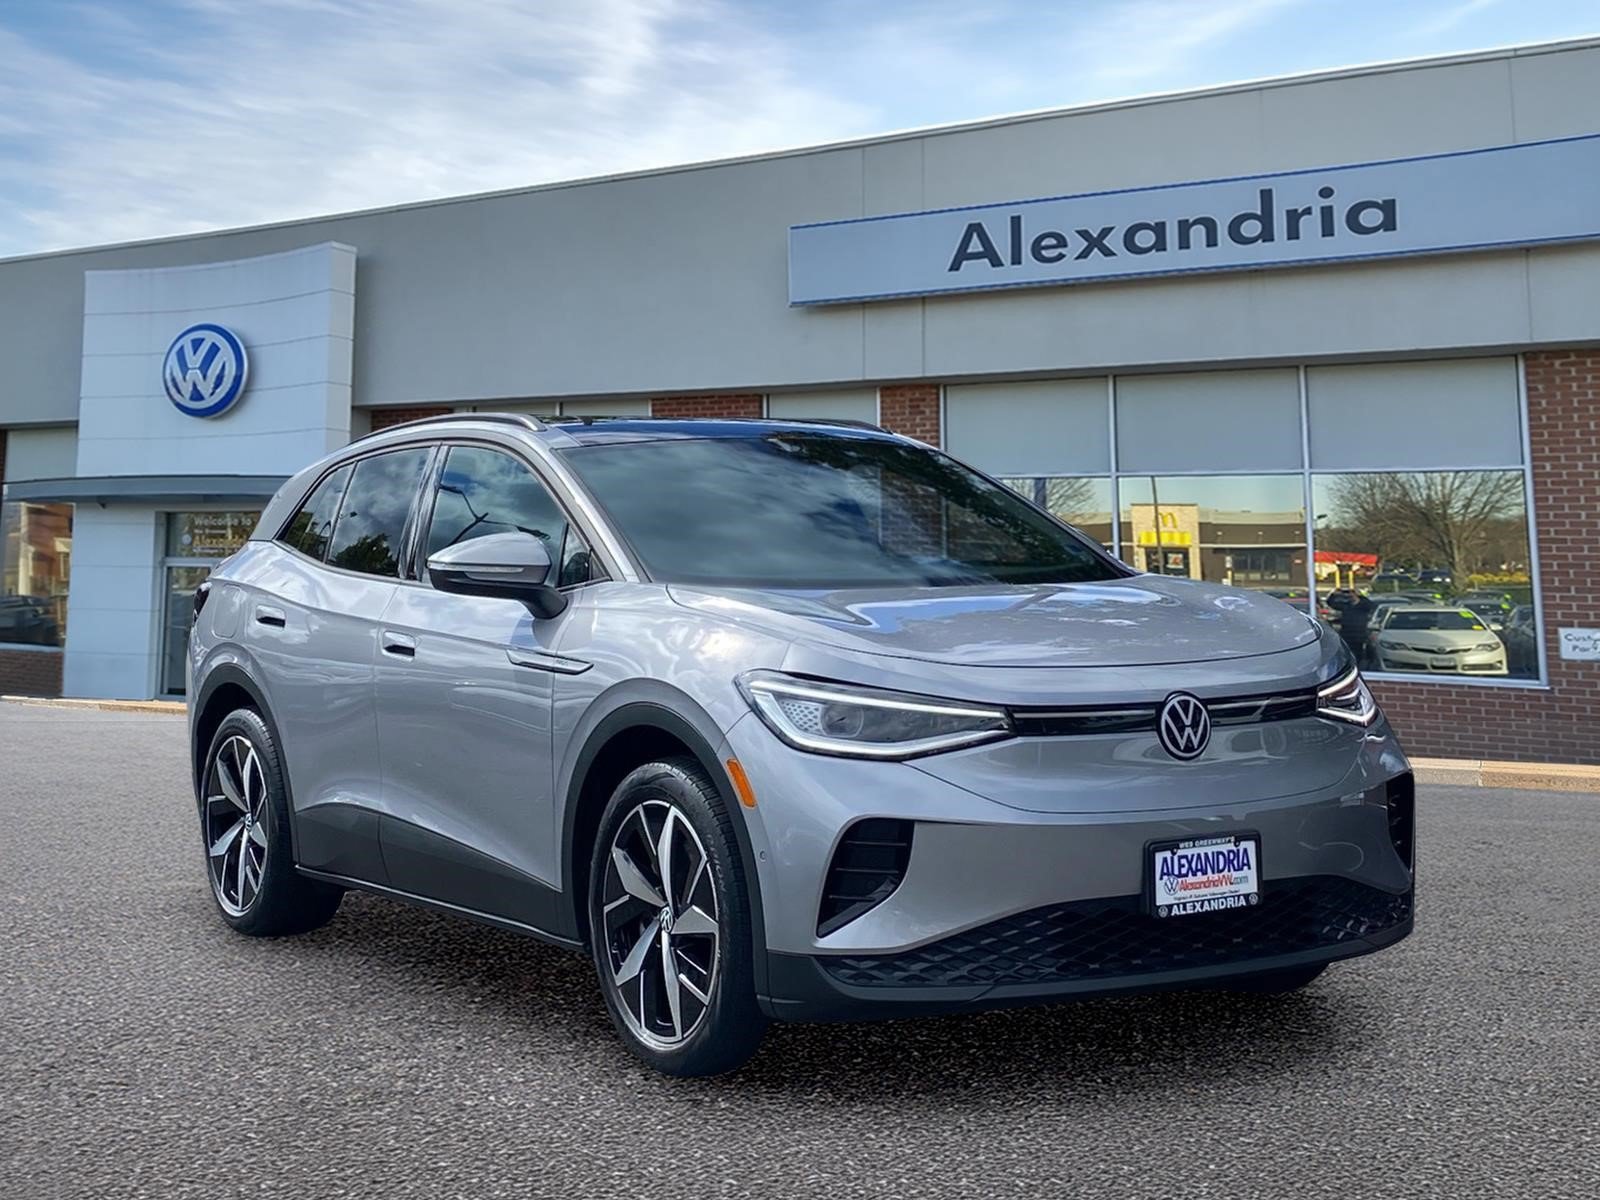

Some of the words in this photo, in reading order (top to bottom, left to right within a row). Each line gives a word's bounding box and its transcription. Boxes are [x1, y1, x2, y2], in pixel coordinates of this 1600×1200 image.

[947, 186, 1398, 273] Alexandria
[1159, 848, 1251, 880] ALEXANDRIA
[1171, 896, 1246, 916] ALEXANDRIA
